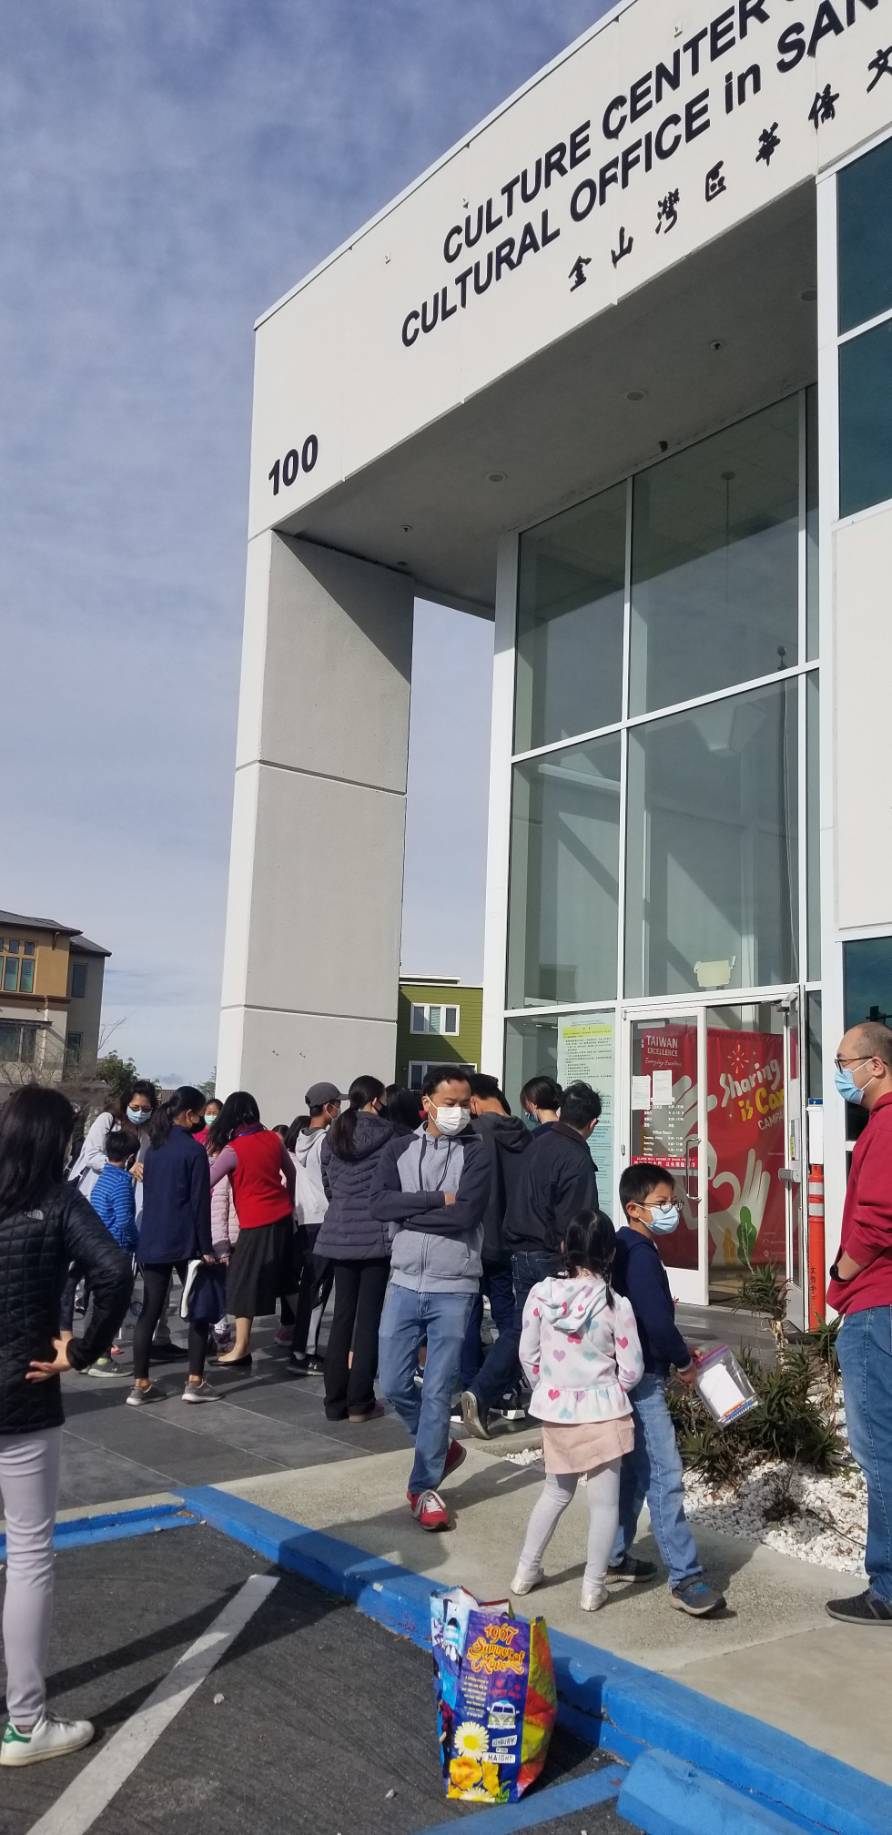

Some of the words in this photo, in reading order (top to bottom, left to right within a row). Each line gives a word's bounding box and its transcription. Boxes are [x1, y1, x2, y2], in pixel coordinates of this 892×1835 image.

[443, 119, 591, 263] CULTURE
[602, 0, 770, 140] CENTER
[401, 209, 560, 347] CULTURAL
[570, 88, 710, 222] OFFICE
[725, 63, 761, 115] in
[268, 434, 318, 496] 100
[645, 1035, 678, 1049] TAIWAN
[720, 1059, 780, 1108] Sharing
[738, 1099, 753, 1121] is
[484, 1623, 519, 1645] 1967
